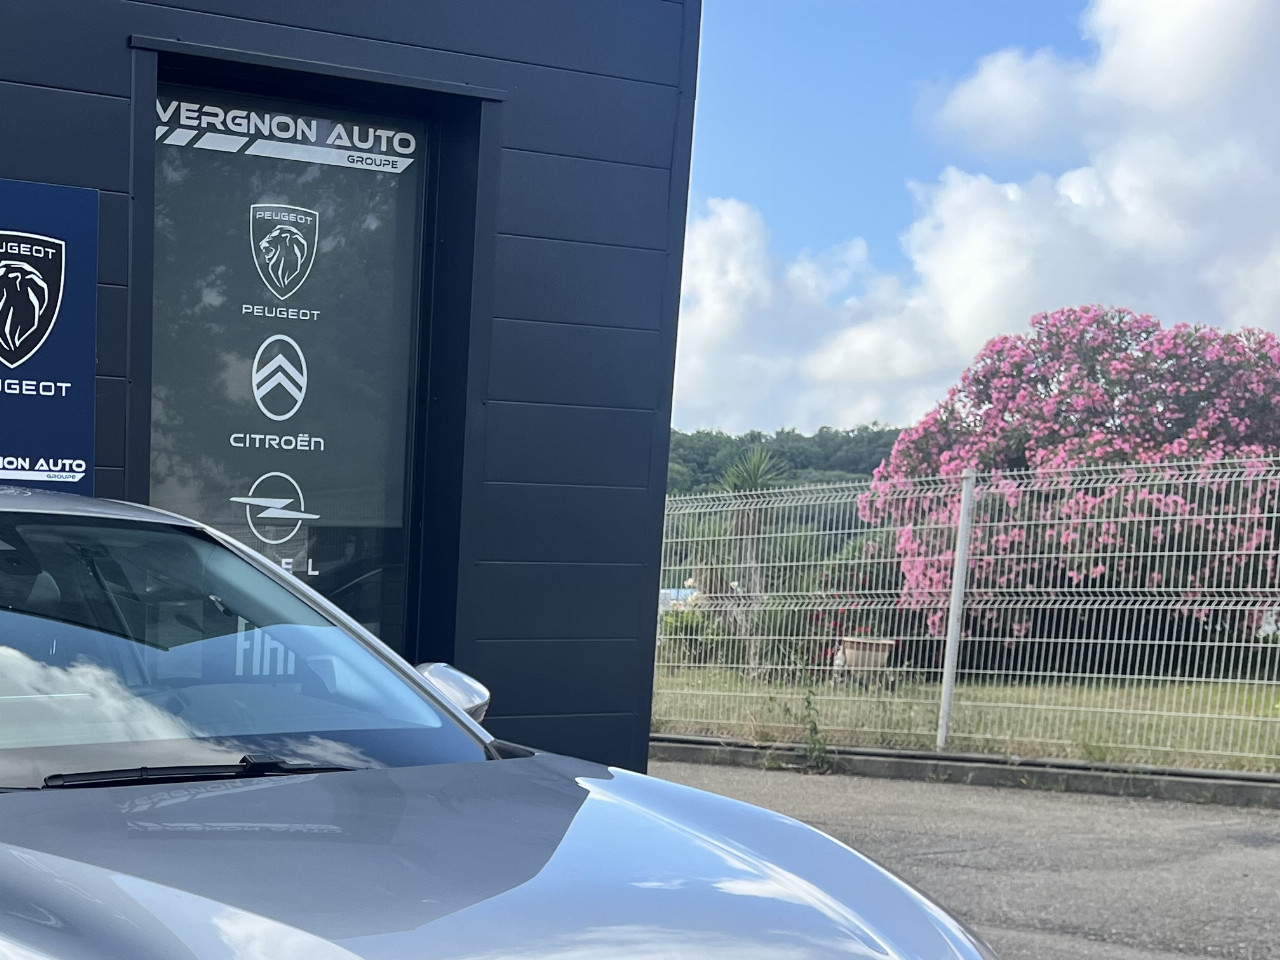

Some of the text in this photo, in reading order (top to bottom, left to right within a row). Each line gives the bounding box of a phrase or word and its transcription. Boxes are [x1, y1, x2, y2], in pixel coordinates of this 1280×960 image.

[156, 99, 416, 154] VERGNON AUTO
[347, 154, 399, 169] GROUPE
[256, 212, 313, 225] PEUGEOT
[242, 304, 320, 321] PEUGEOT
[229, 433, 325, 451] CITROËN
[34, 458, 87, 472] AUTO
[281, 558, 320, 576] EL
